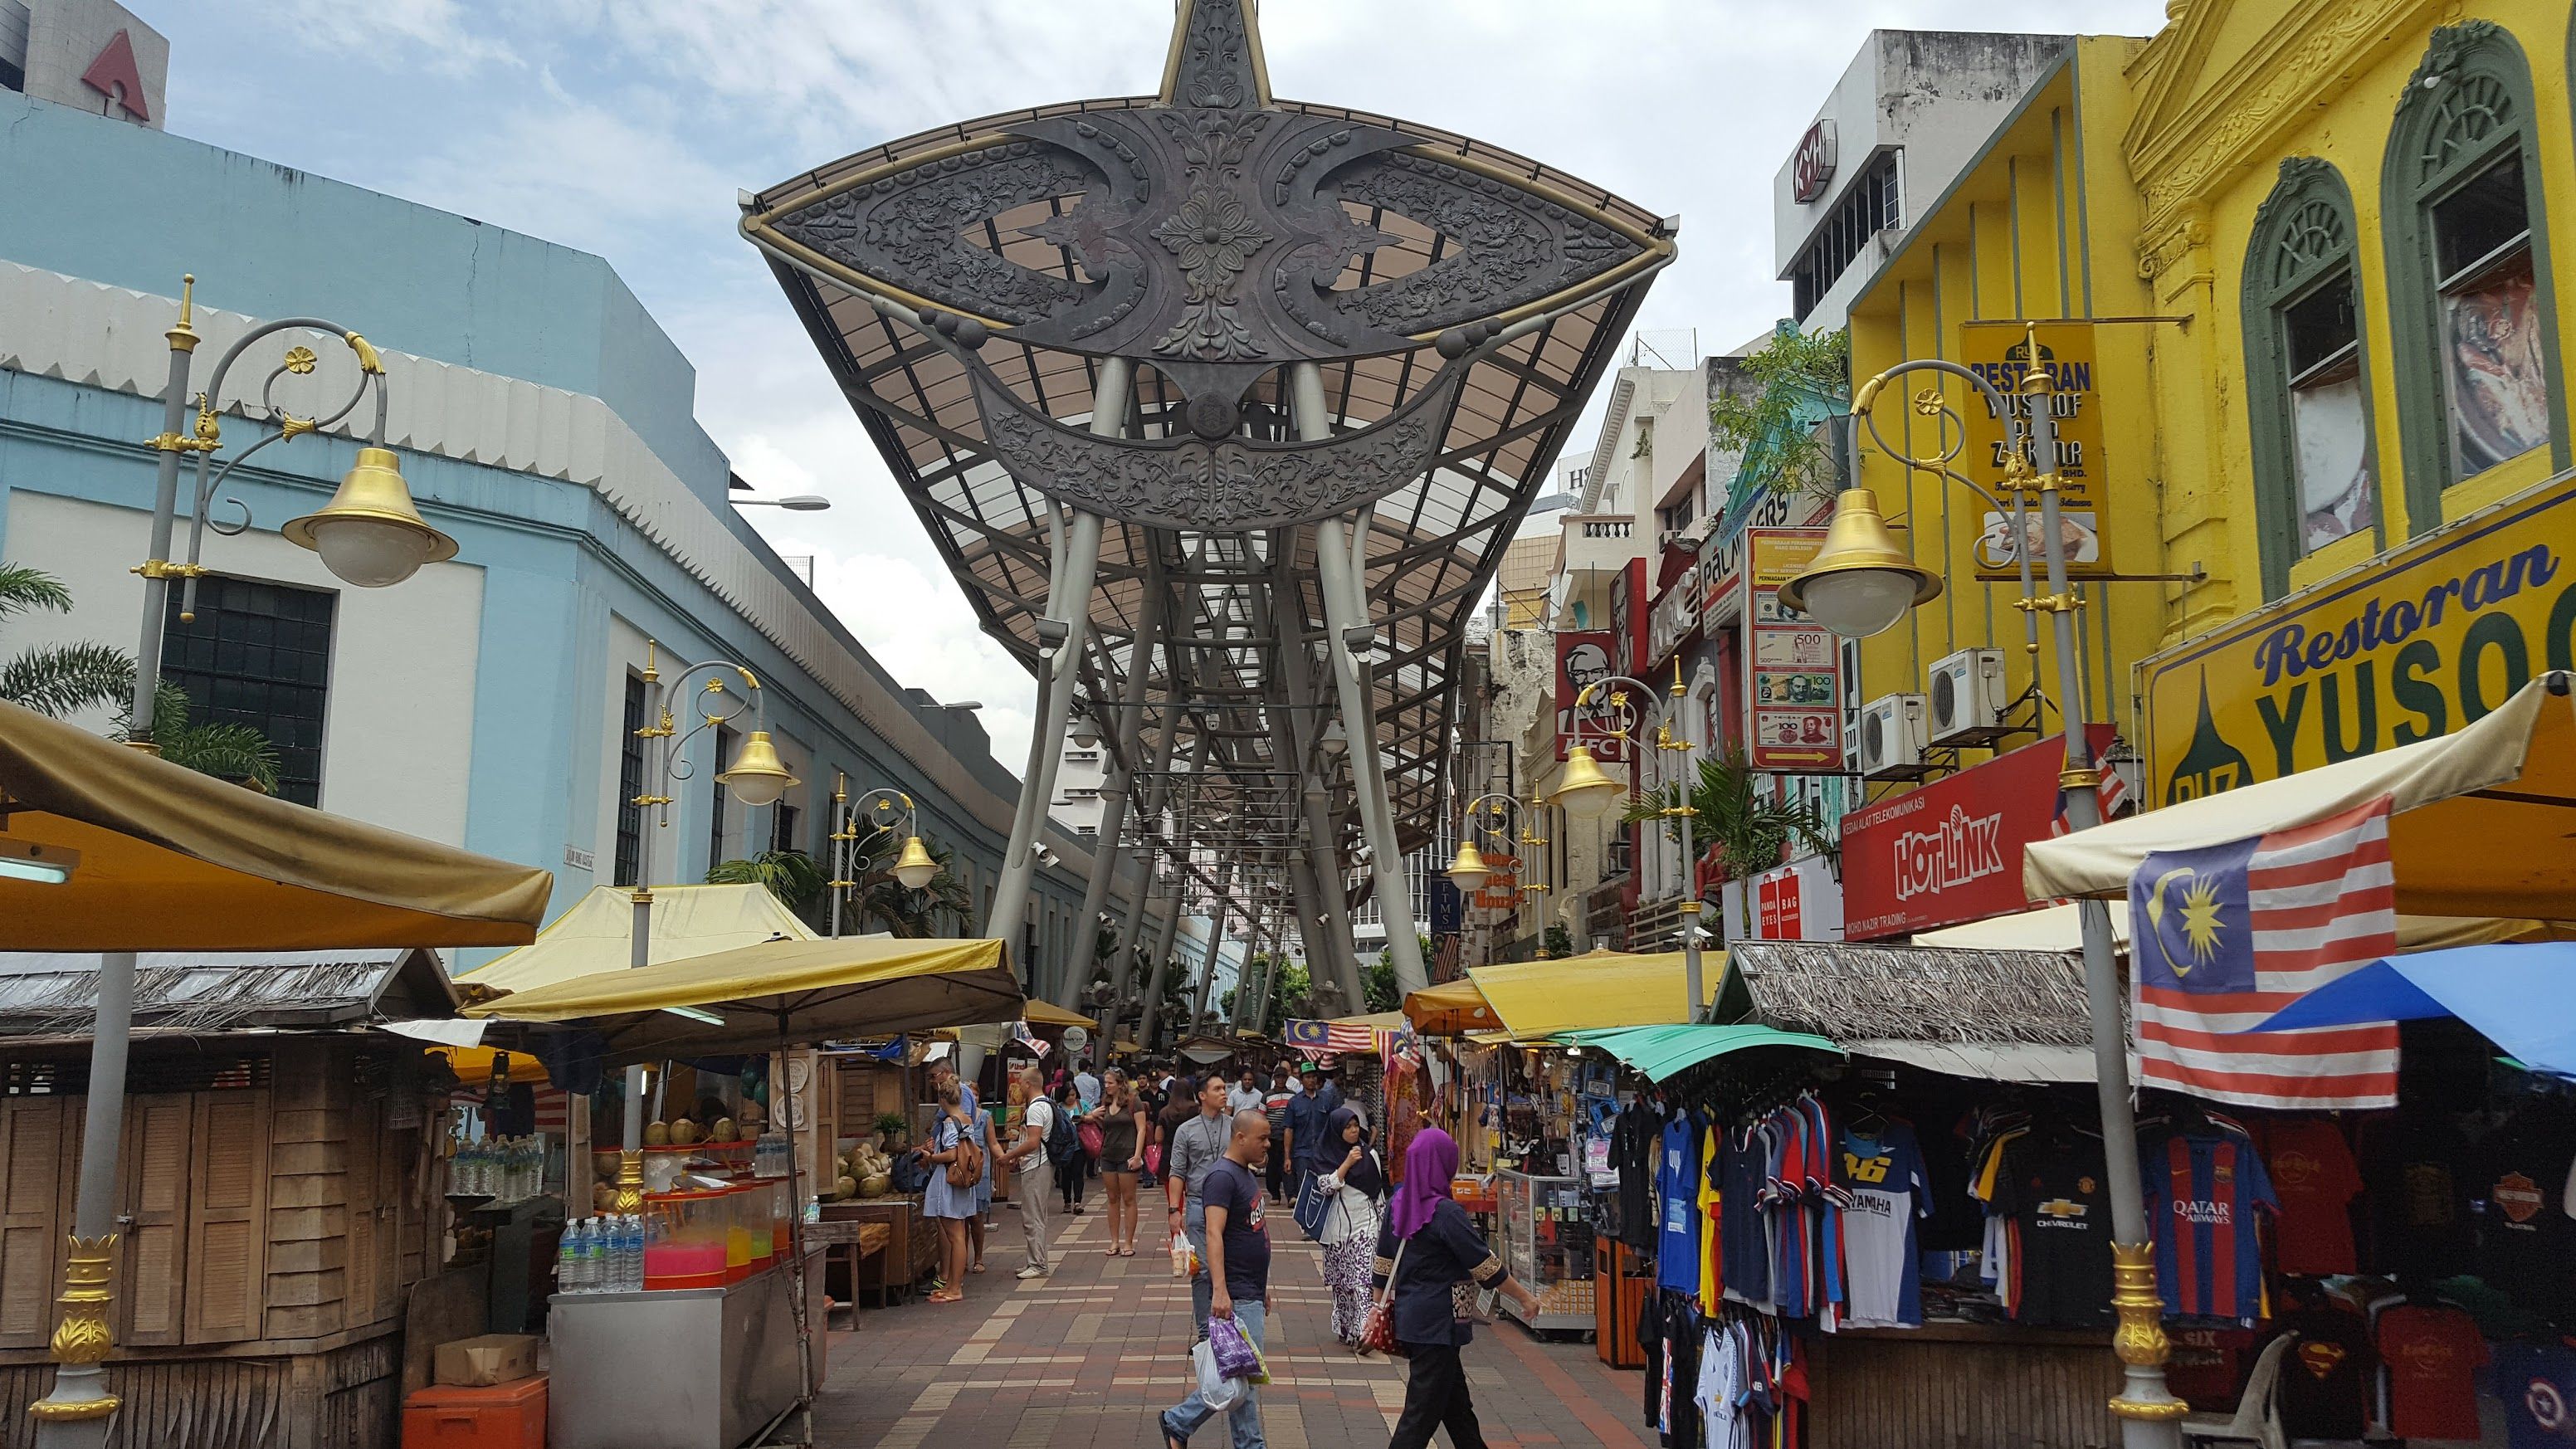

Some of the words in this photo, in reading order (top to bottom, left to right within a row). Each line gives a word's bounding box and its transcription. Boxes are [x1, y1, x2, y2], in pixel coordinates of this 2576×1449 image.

[1971, 363, 2091, 393] RESTRAN
[2254, 544, 2560, 687] Restoran
[1797, 634, 1821, 645] 500
[1812, 676, 1831, 685] 100
[1778, 722, 1798, 730] 100
[1842, 820, 1859, 836] KEDAI
[1859, 815, 1872, 830] ALAT
[1872, 796, 1925, 824] TELEKOMUNIKASI
[1761, 900, 1776, 912] PANDA
[1782, 896, 1798, 910] BAG
[1762, 915, 1777, 926] EYES
[1846, 921, 1862, 935] MOHD
[1862, 917, 1879, 930] NAZIR
[1879, 911, 1906, 927] TRADING
[2173, 1200, 2230, 1217] QATAR
[2186, 1213, 2231, 1224] AIRWAYS
[2037, 1220, 2089, 1230] CHEVROLET
